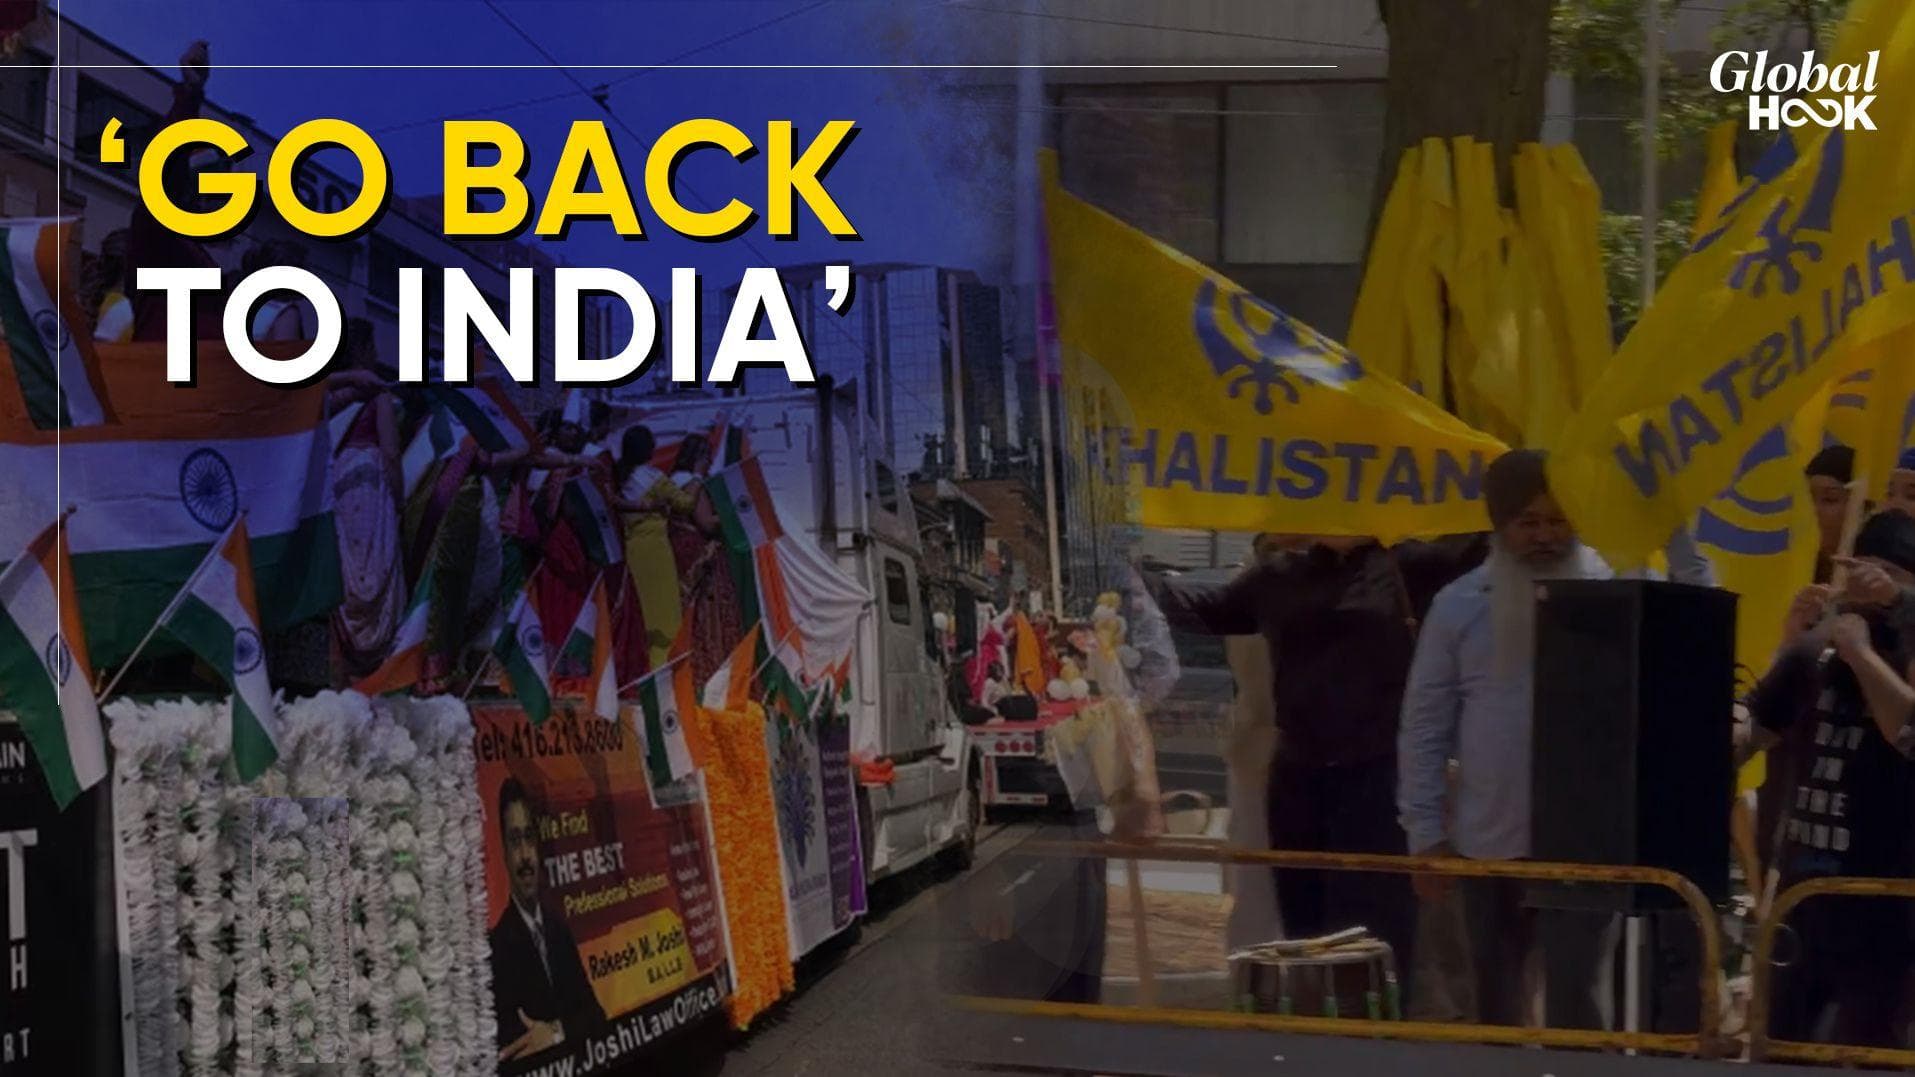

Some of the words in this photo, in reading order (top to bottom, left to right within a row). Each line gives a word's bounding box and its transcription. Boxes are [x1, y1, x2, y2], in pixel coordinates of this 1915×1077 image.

[0, 741, 26, 769] IN
[544, 852, 582, 888] THE
[582, 842, 625, 879] BEST
[589, 942, 638, 980] Rakesh
